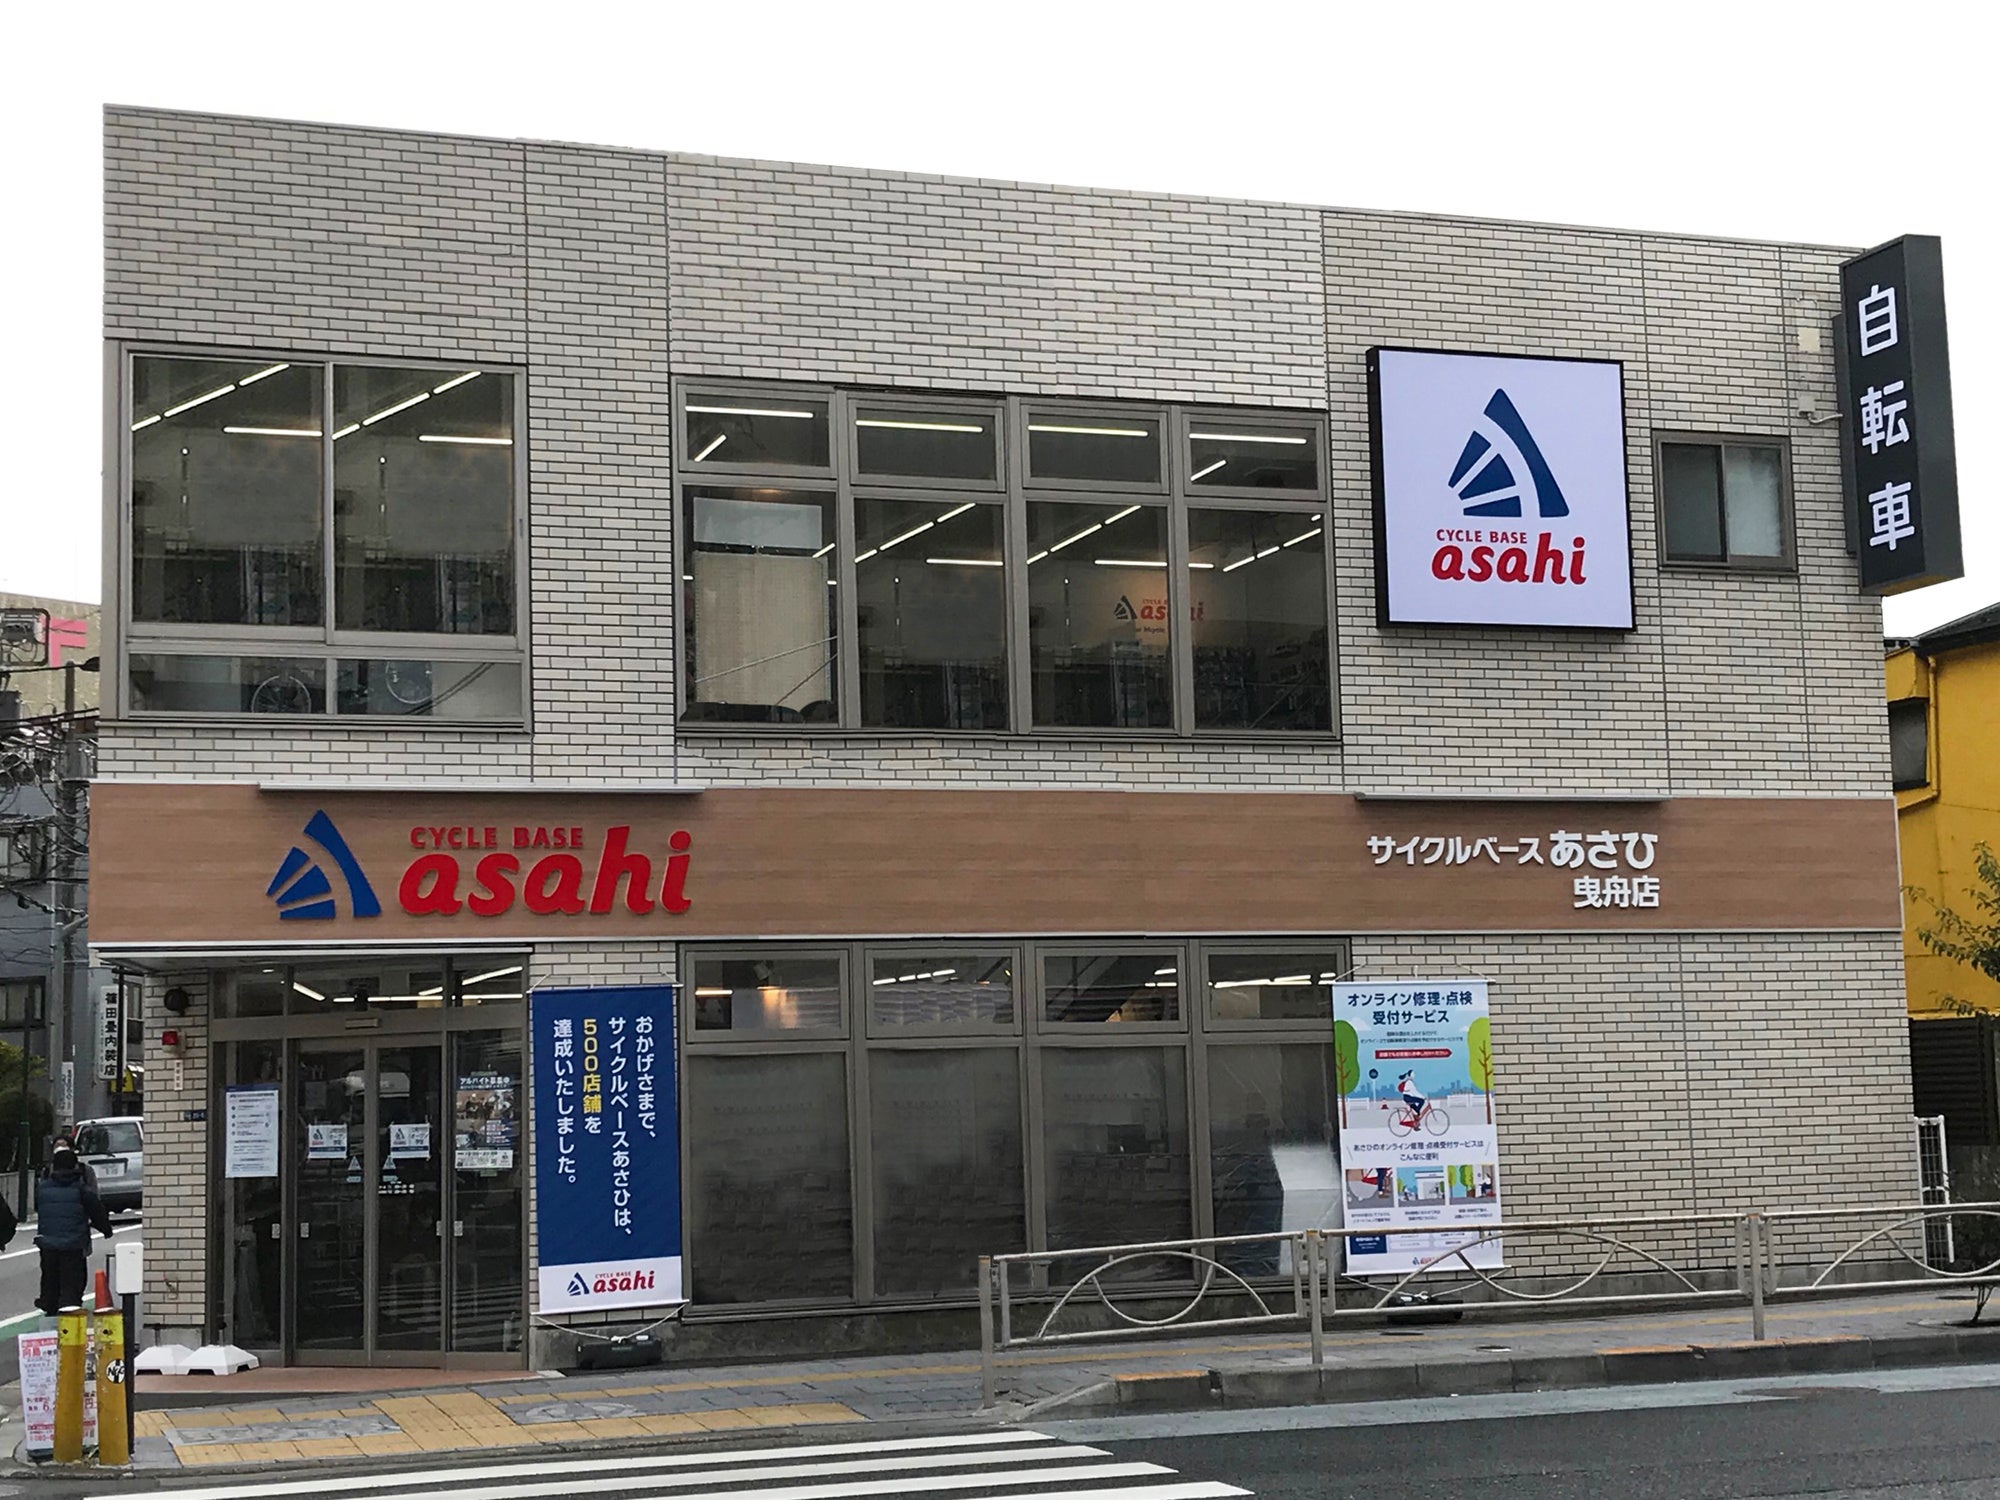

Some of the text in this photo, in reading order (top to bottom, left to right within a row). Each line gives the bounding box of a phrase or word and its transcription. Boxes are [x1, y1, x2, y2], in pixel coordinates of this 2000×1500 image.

[1858, 284, 1915, 550] 自転車
[1436, 528, 1528, 544] CYCLE BASE
[1431, 532, 1586, 585] asahi
[410, 826, 584, 849] CYCLE BASE
[1366, 830, 1659, 869] サイクルベースあさひ
[398, 825, 693, 916] asahi
[1573, 875, 1660, 908] 曳舟店
[1347, 990, 1473, 1008] オンライン修理・点検
[1372, 1010, 1450, 1026] 受付サービス
[635, 1015, 657, 1138] おかげさまで、
[553, 1018, 577, 1184] 達成いたしました。
[607, 1016, 632, 1235] サイクルベースあさひは、
[593, 1270, 655, 1294] asahi
